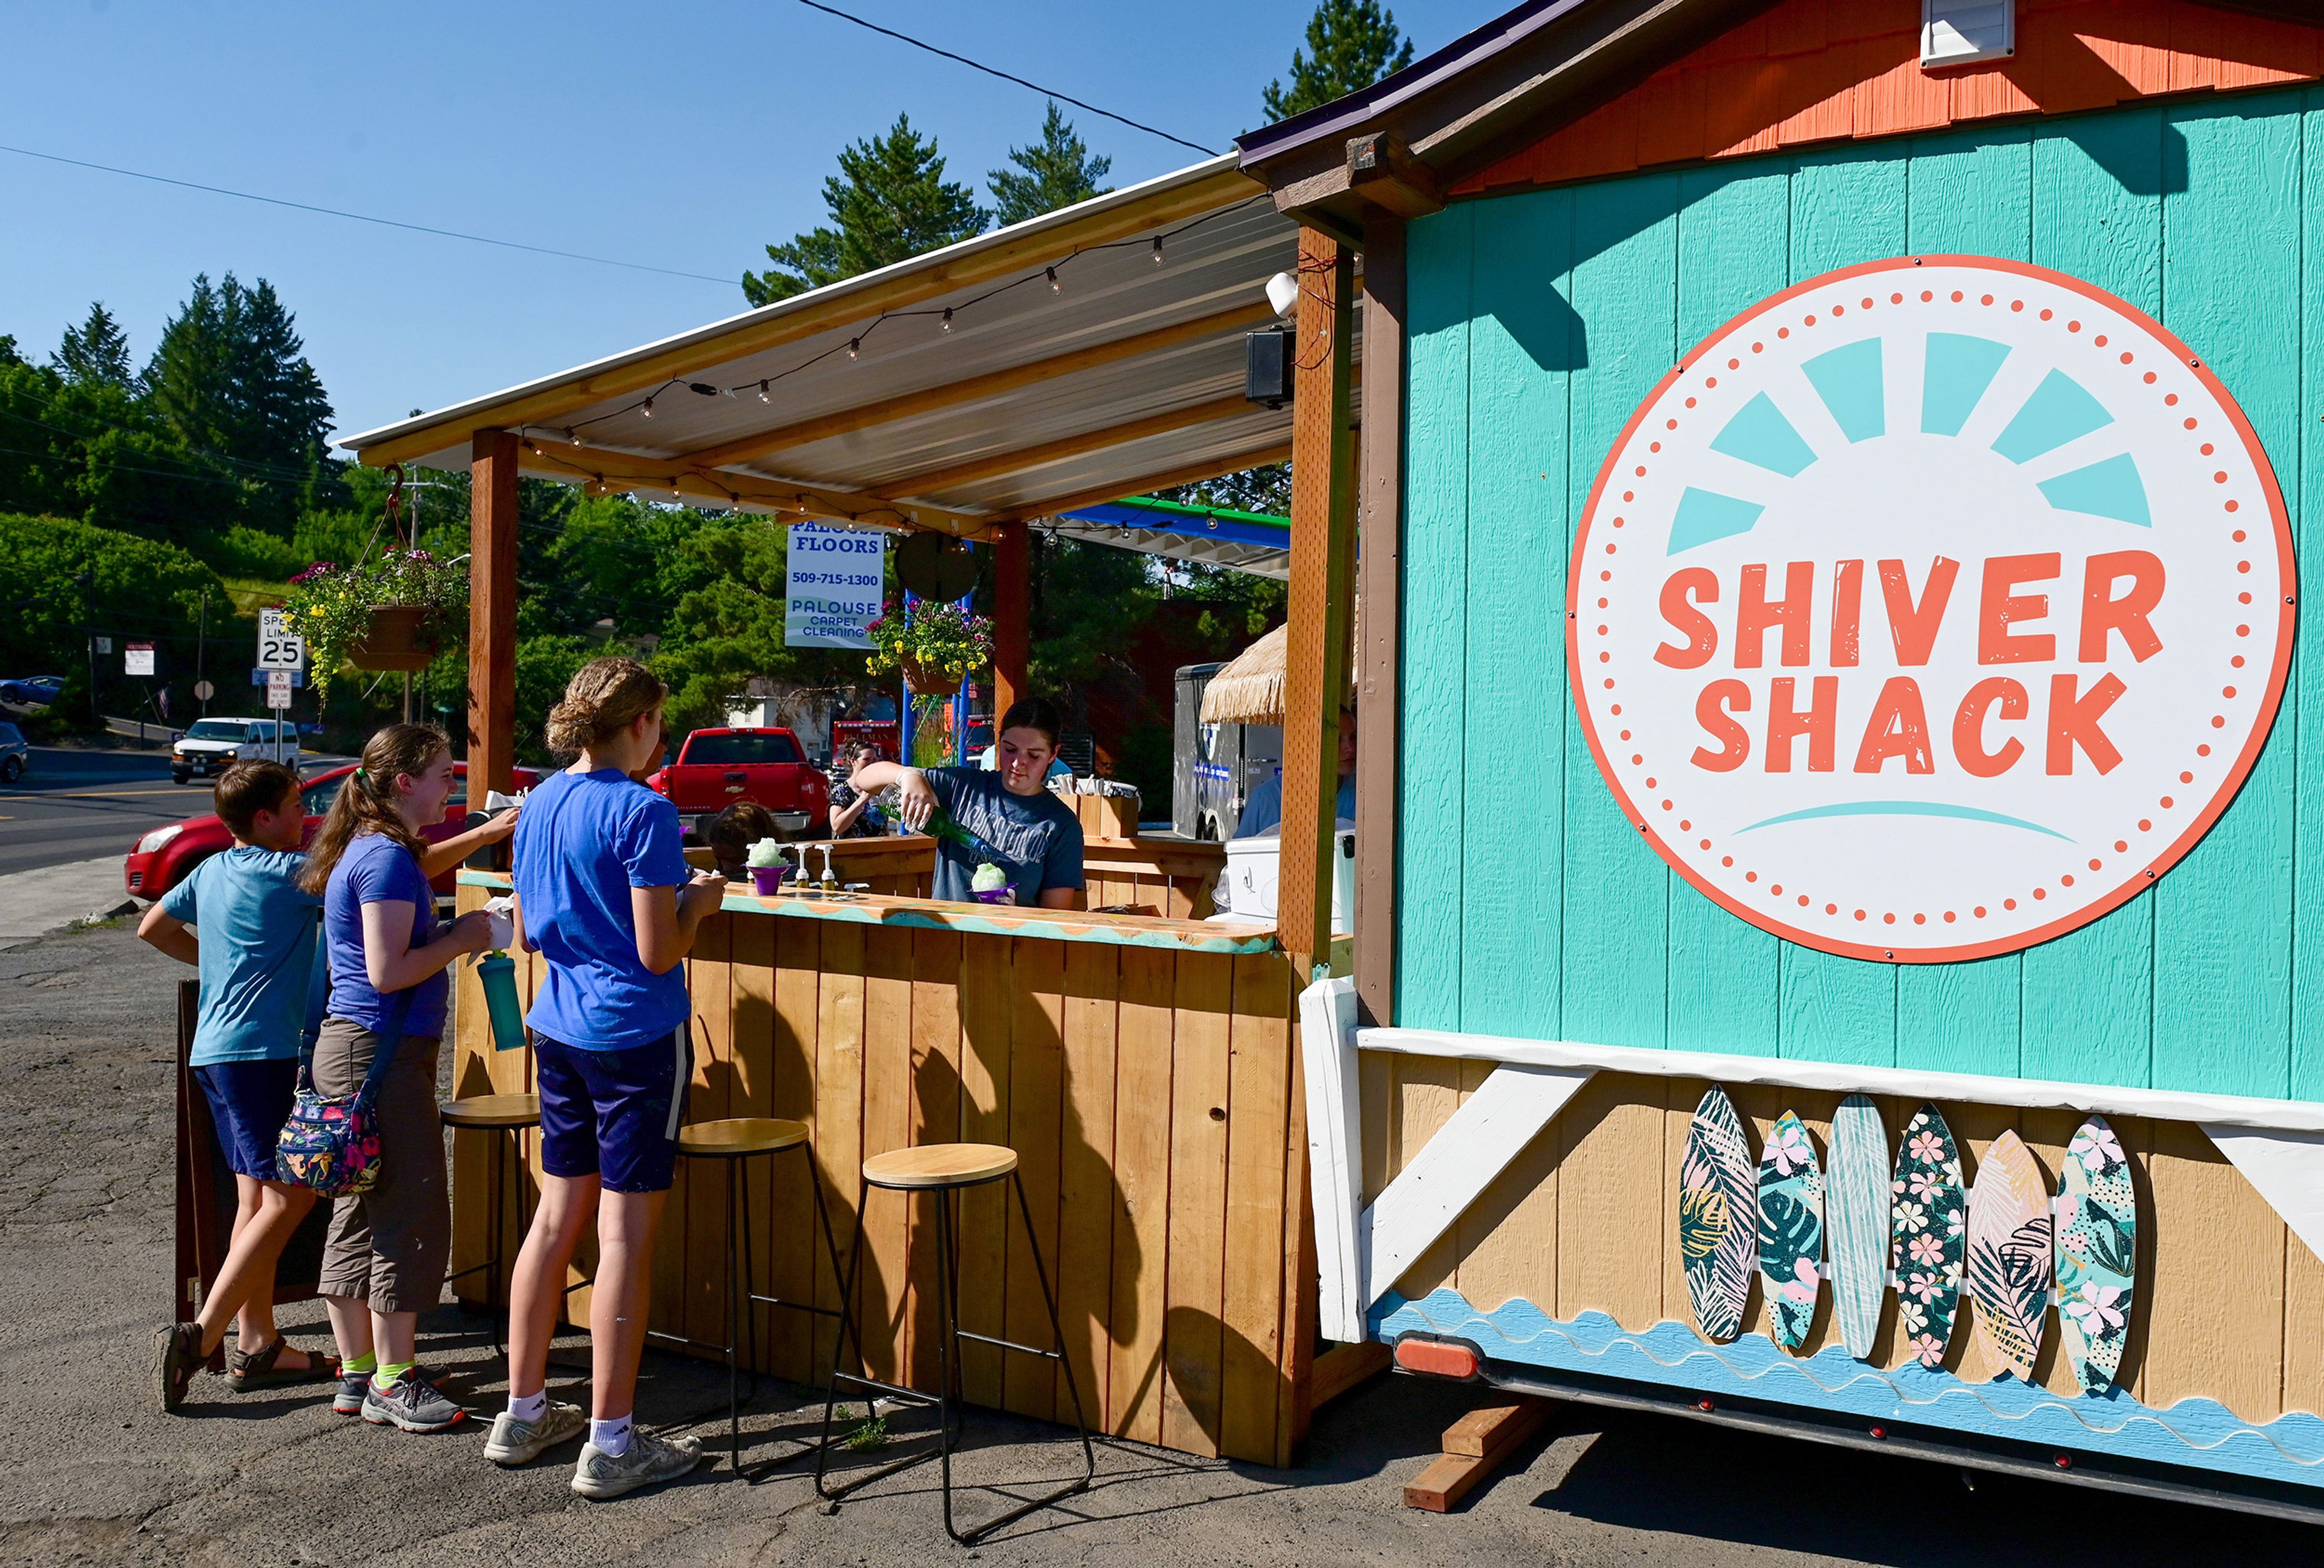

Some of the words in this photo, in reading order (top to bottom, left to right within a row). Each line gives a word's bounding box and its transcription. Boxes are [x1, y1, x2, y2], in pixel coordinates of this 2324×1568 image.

[796, 536, 878, 554] FLOORS
[792, 572, 878, 586] 509-715-1300
[792, 600, 876, 615] PALOUSE
[1653, 550, 2167, 669] SHIVER
[264, 616, 286, 626] SPE
[810, 616, 858, 626] CARPET
[267, 629, 294, 638] LIMI
[803, 626, 864, 638] CLEANING
[263, 641, 298, 663] 25
[1690, 672, 2128, 778] SHACK
